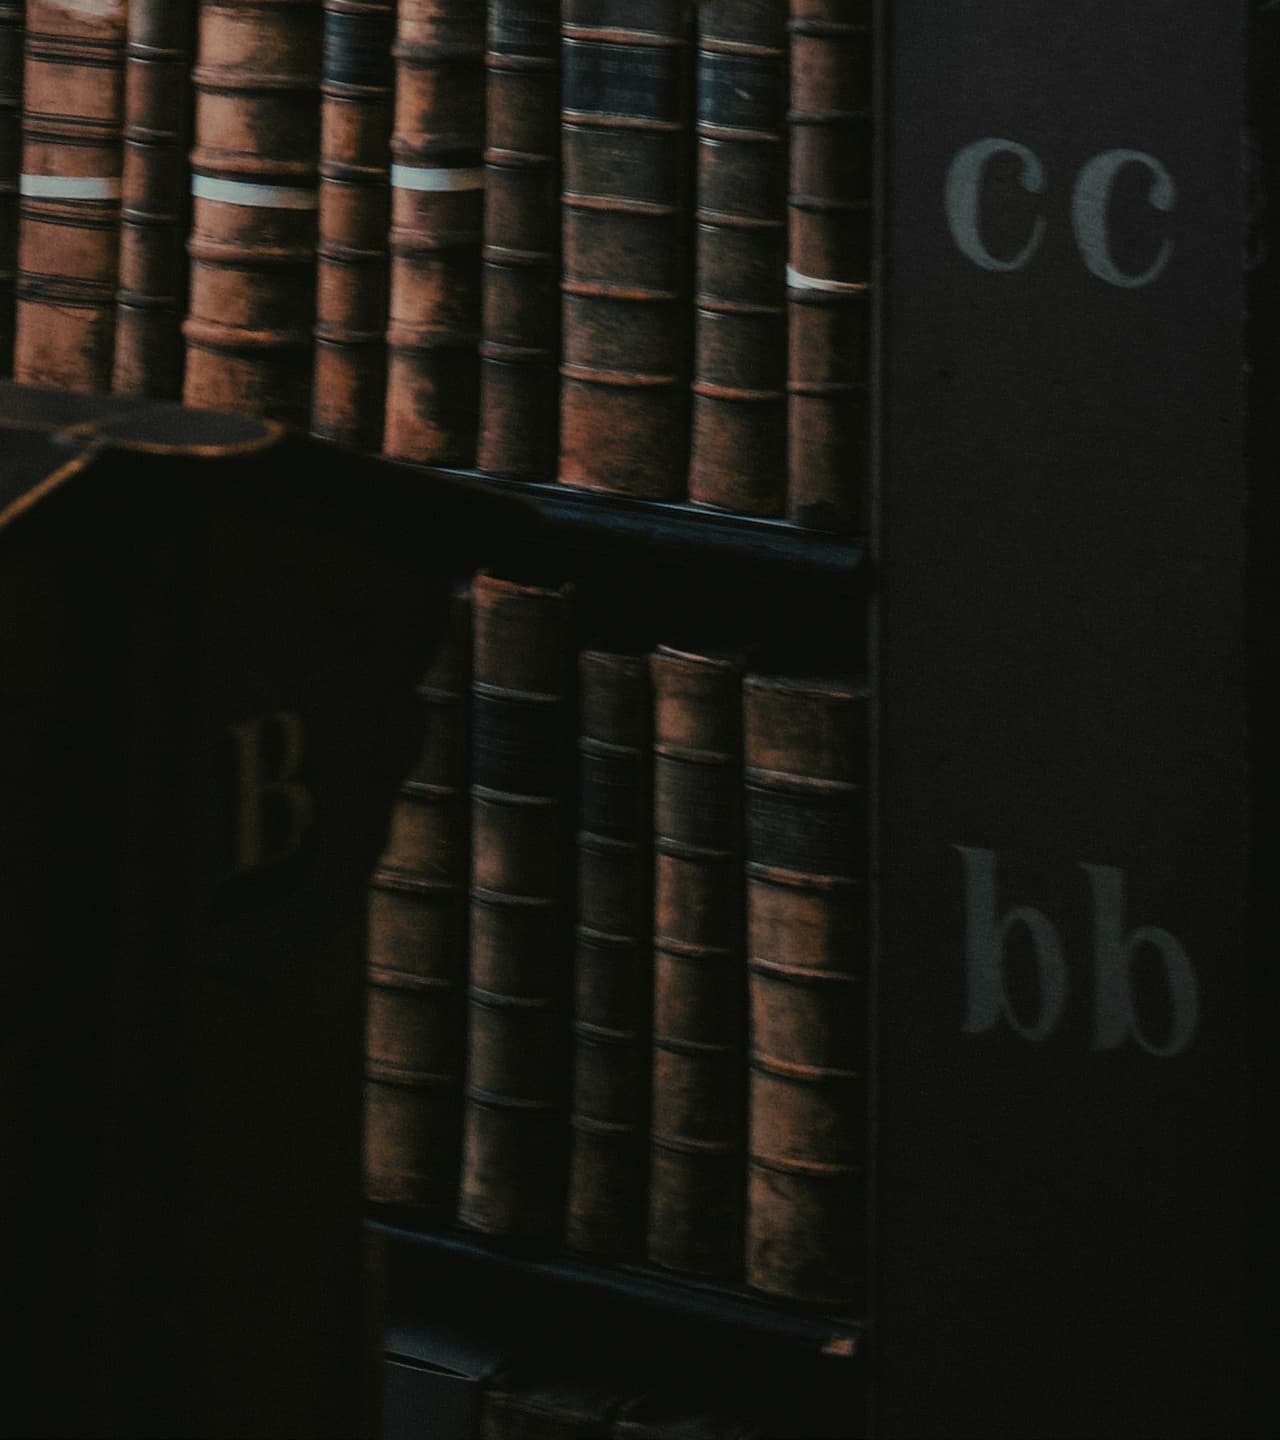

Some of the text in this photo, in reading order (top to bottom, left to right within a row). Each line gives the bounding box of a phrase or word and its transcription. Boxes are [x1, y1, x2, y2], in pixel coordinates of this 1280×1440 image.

[944, 135, 1176, 288] cc
[225, 708, 316, 875] B
[953, 842, 1199, 1057] bb
